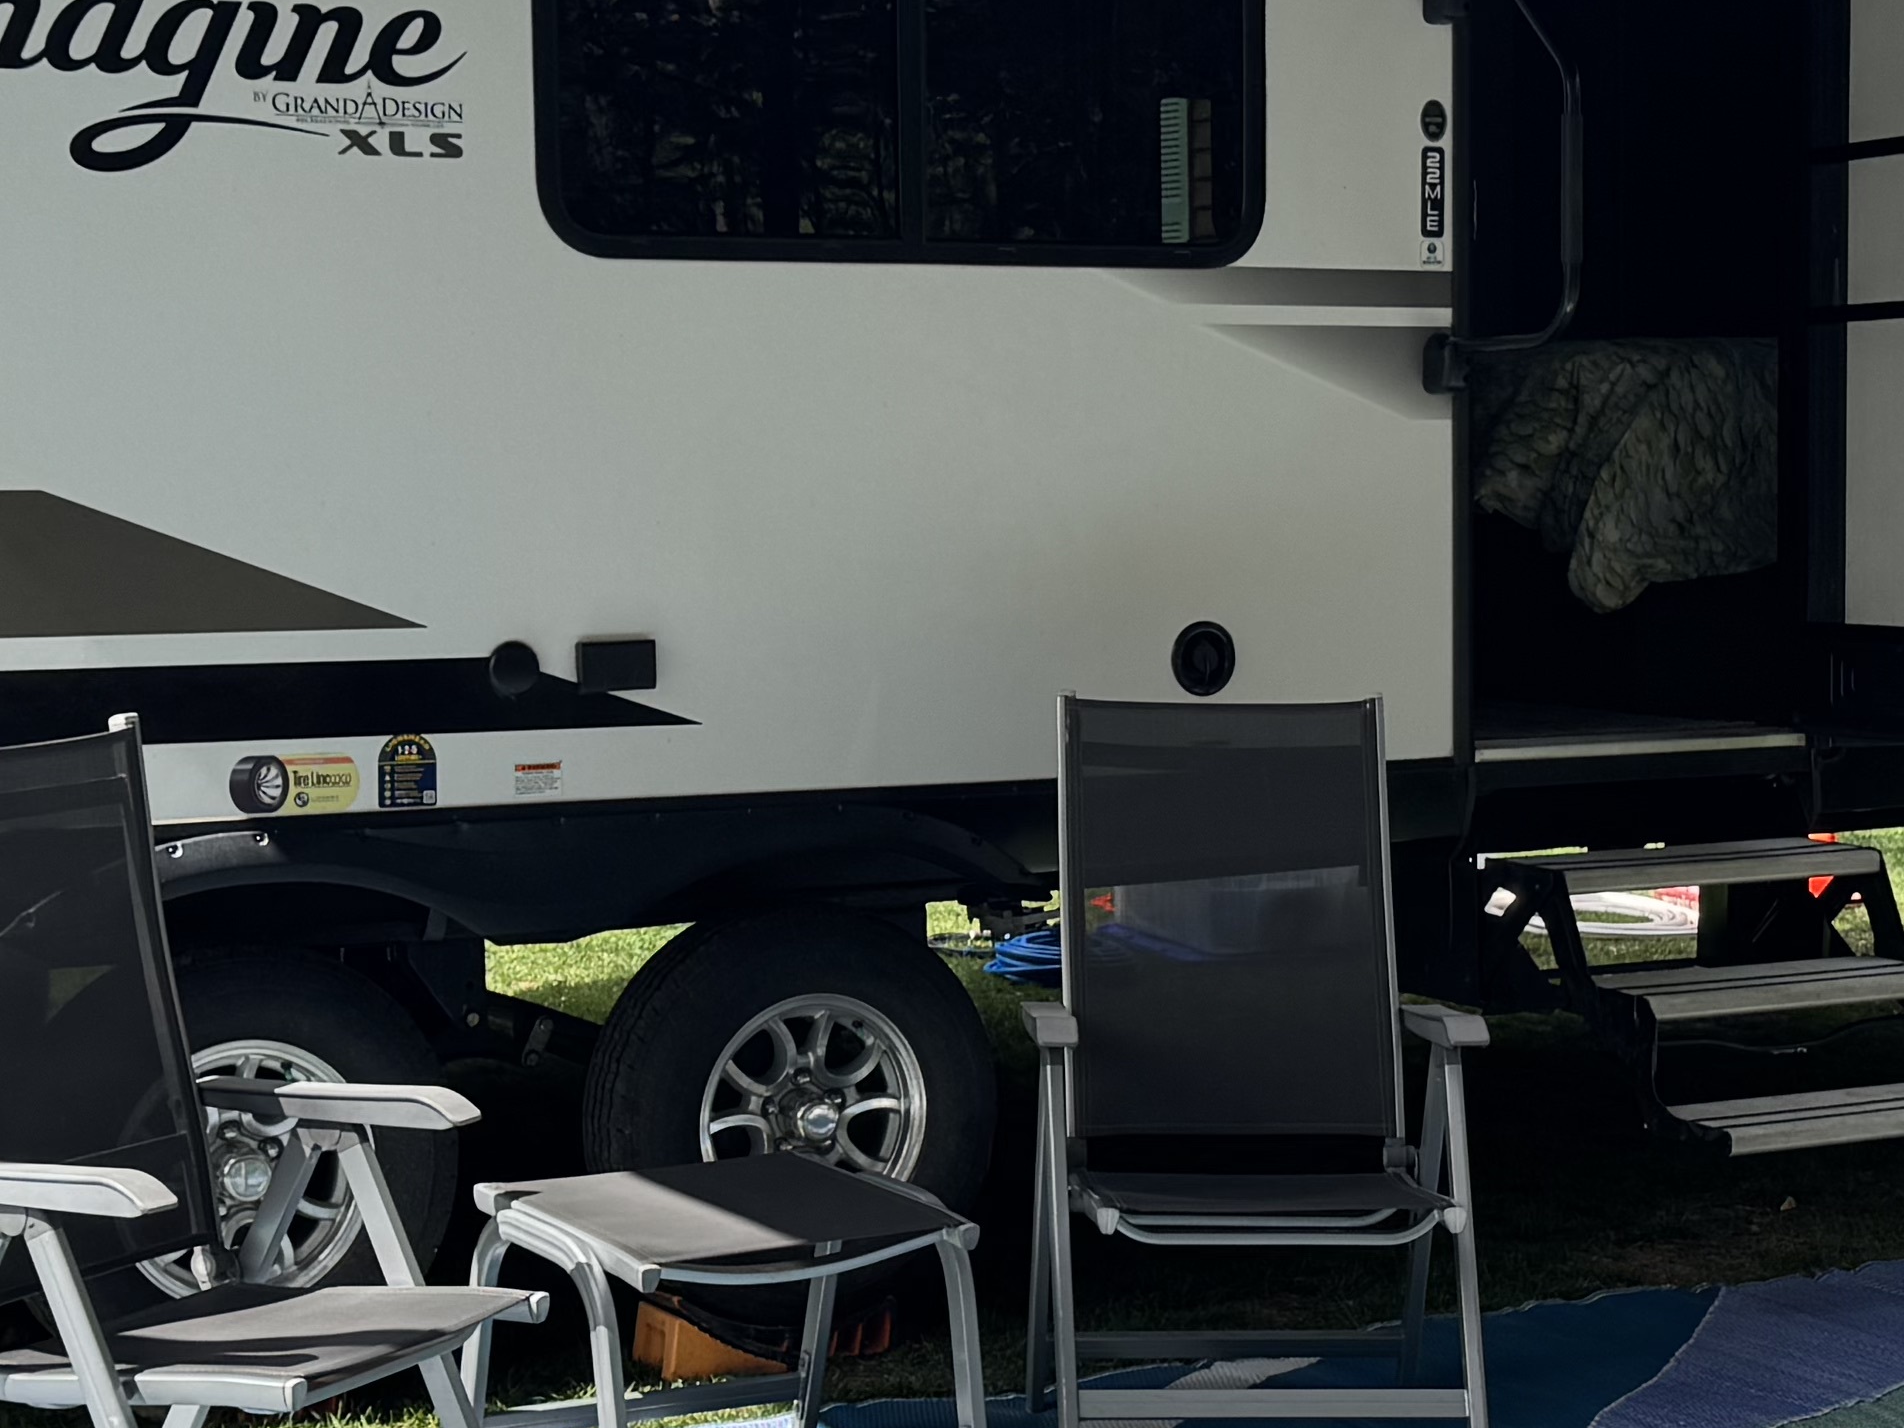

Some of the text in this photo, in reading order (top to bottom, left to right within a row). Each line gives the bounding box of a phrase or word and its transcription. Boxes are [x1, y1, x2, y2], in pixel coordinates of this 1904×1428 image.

[272, 92, 359, 116] GRAND
[383, 97, 463, 121] DESIGN
[338, 129, 464, 159] XLS
[1425, 151, 1441, 232] 22MLE
